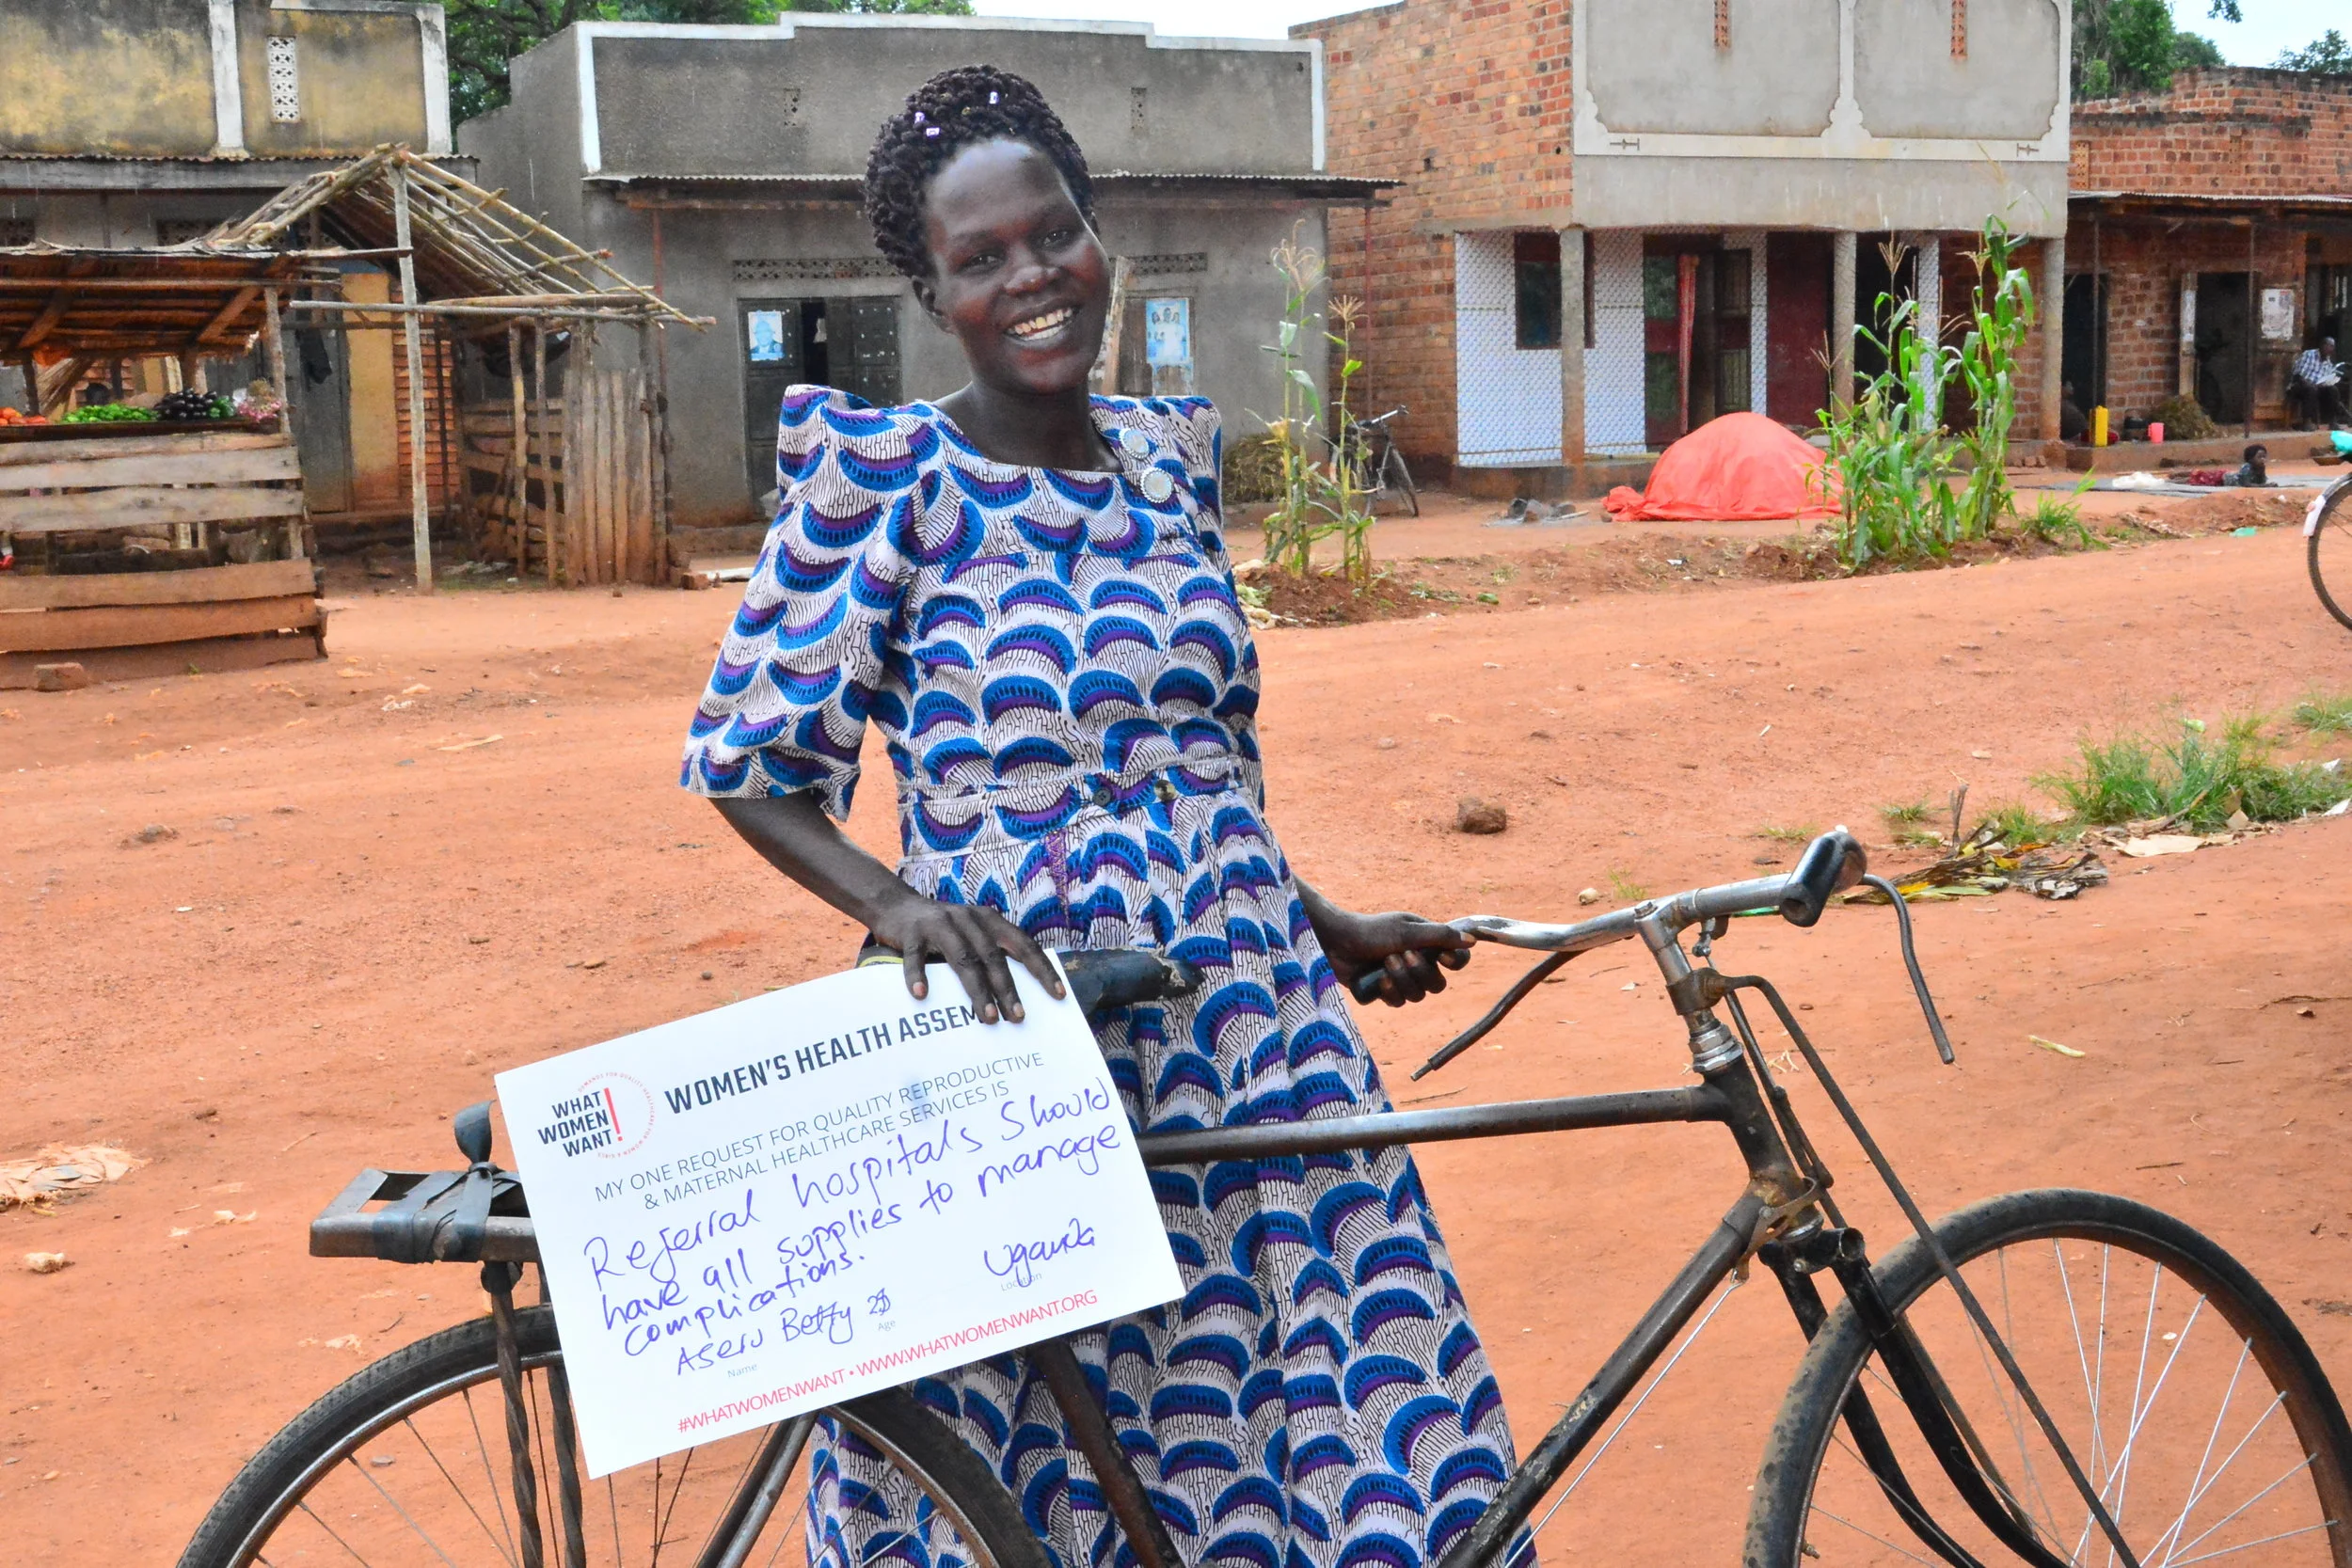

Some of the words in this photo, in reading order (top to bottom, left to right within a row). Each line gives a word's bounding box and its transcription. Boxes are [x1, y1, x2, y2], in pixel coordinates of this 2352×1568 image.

[551, 1091, 601, 1119] WHAT
[664, 1053, 791, 1115] WOMEN'S
[795, 1022, 893, 1074] HEALTH
[898, 1004, 1009, 1043] ASSEM
[537, 1109, 610, 1145] WOMEN
[595, 1179, 624, 1202] MY
[630, 1164, 674, 1190] ONE
[676, 1133, 764, 1177] REQUEST
[769, 1120, 810, 1147] FOR
[813, 1092, 893, 1133] QUALITY
[898, 1052, 1045, 1104] REPRODUCTIVE
[644, 1193, 660, 1210] &
[663, 1158, 769, 1204] MATERNAL
[771, 1115, 897, 1169] HEALTHCARE
[899, 1085, 988, 1128] SERVICES
[991, 1080, 1009, 1099] IS
[583, 1188, 761, 1292] Referral
[792, 1119, 983, 1209] hospitals
[602, 1279, 689, 1331] have
[703, 1247, 753, 1294] all
[919, 1179, 954, 1215] to
[977, 1124, 1121, 1198] manage
[877, 1318, 897, 1333] Age
[1000, 1271, 1043, 1292] Location
[677, 1368, 847, 1434] #WHATWOMENWANT
[855, 1289, 1099, 1378] WWW.WHATWOMENWANT.ORG
[726, 1363, 758, 1379] Name
